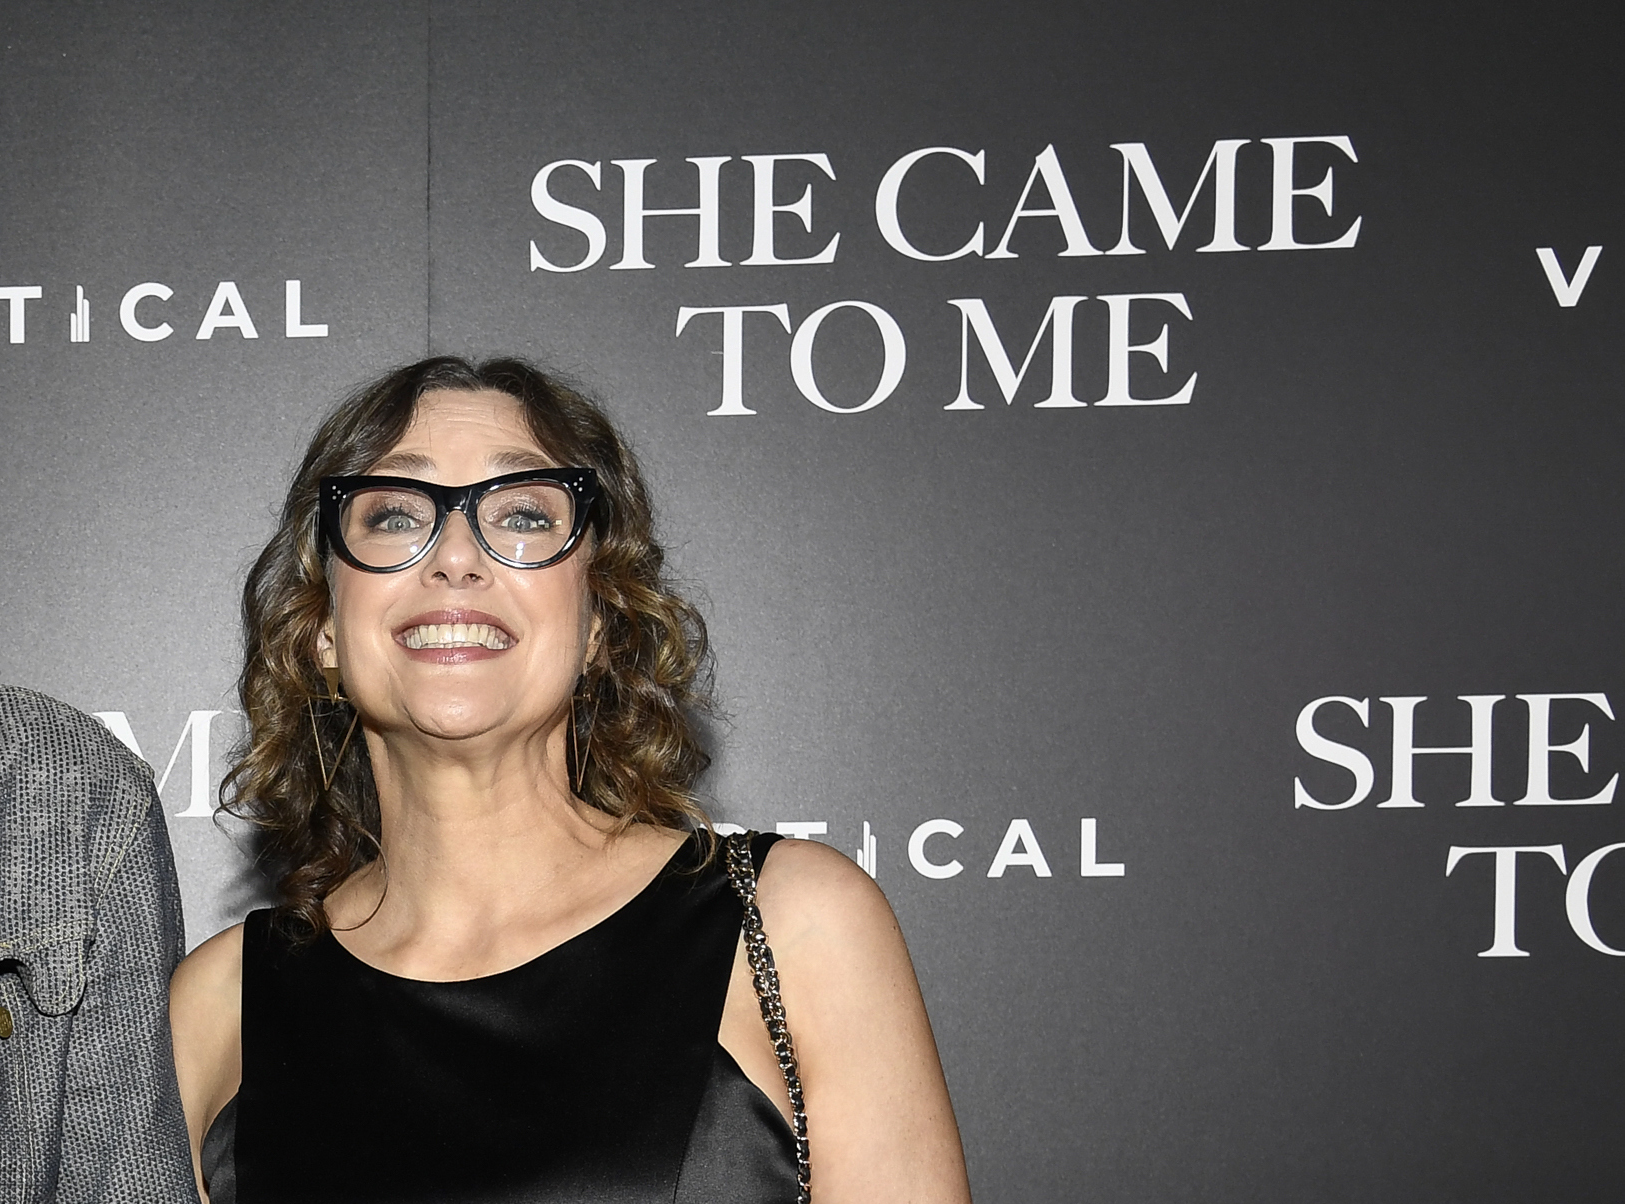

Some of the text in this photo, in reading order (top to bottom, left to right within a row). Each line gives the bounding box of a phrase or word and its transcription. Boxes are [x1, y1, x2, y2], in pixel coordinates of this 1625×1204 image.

[530, 135, 1363, 273] SHE CAME
[675, 292, 1198, 416] TO ME
[1294, 692, 1620, 811] SHE
